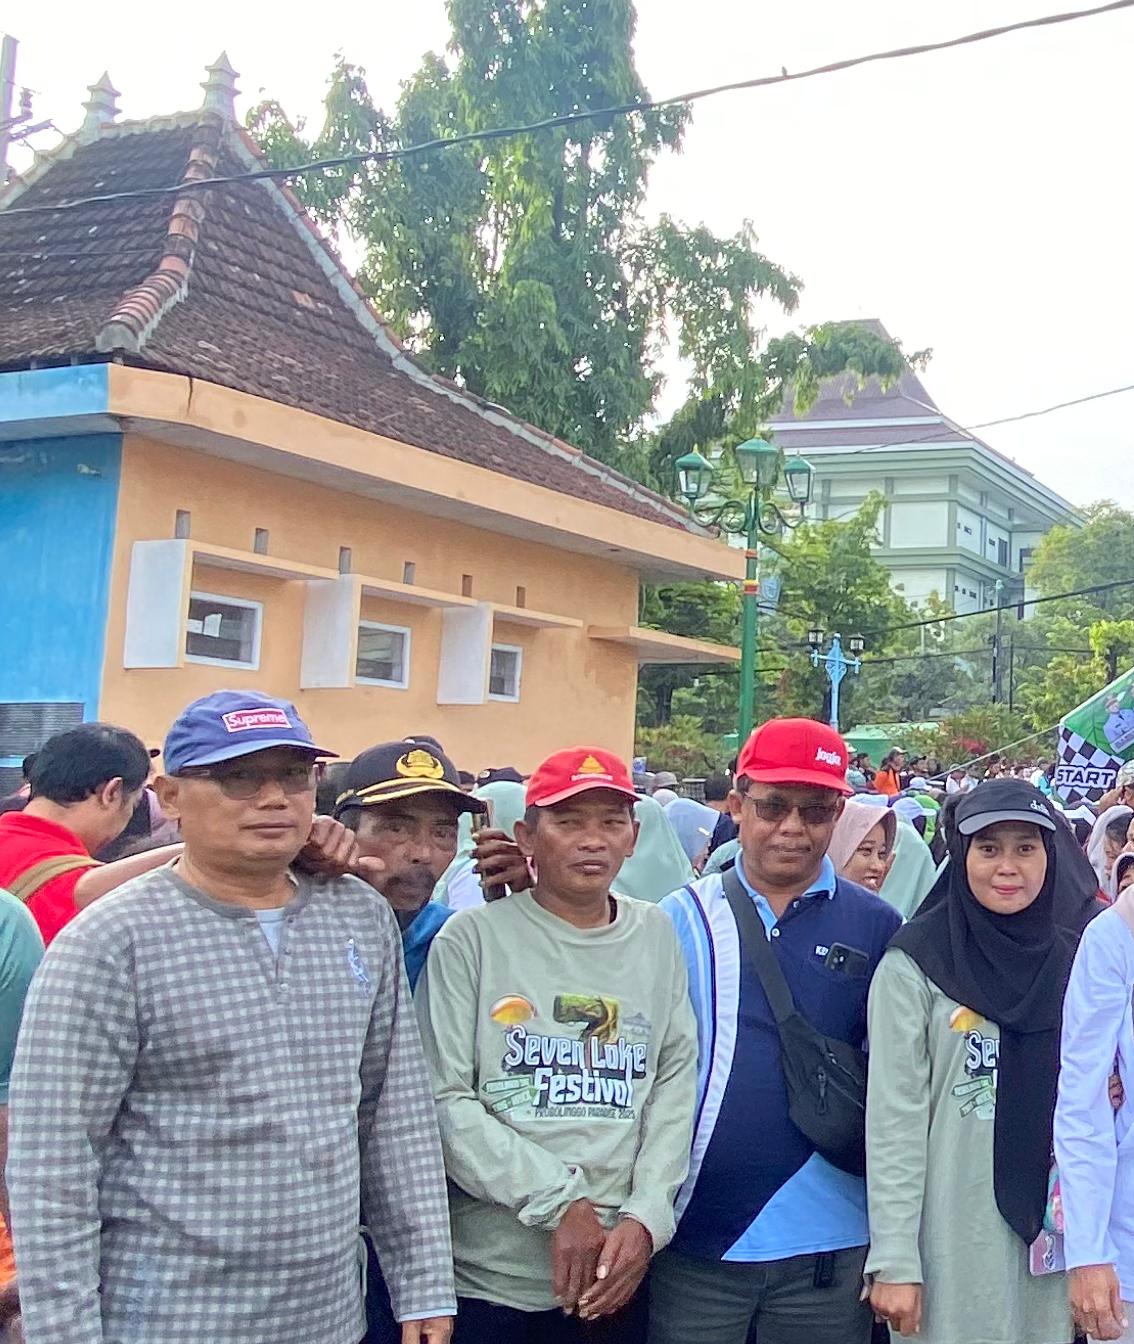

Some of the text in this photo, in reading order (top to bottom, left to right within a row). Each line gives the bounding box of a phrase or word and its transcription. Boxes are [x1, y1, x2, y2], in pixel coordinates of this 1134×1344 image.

[228, 712, 288, 727] Supreme
[1056, 767, 1115, 787] START
[505, 1025, 585, 1071] Seven
[533, 1067, 633, 1107] Festival
